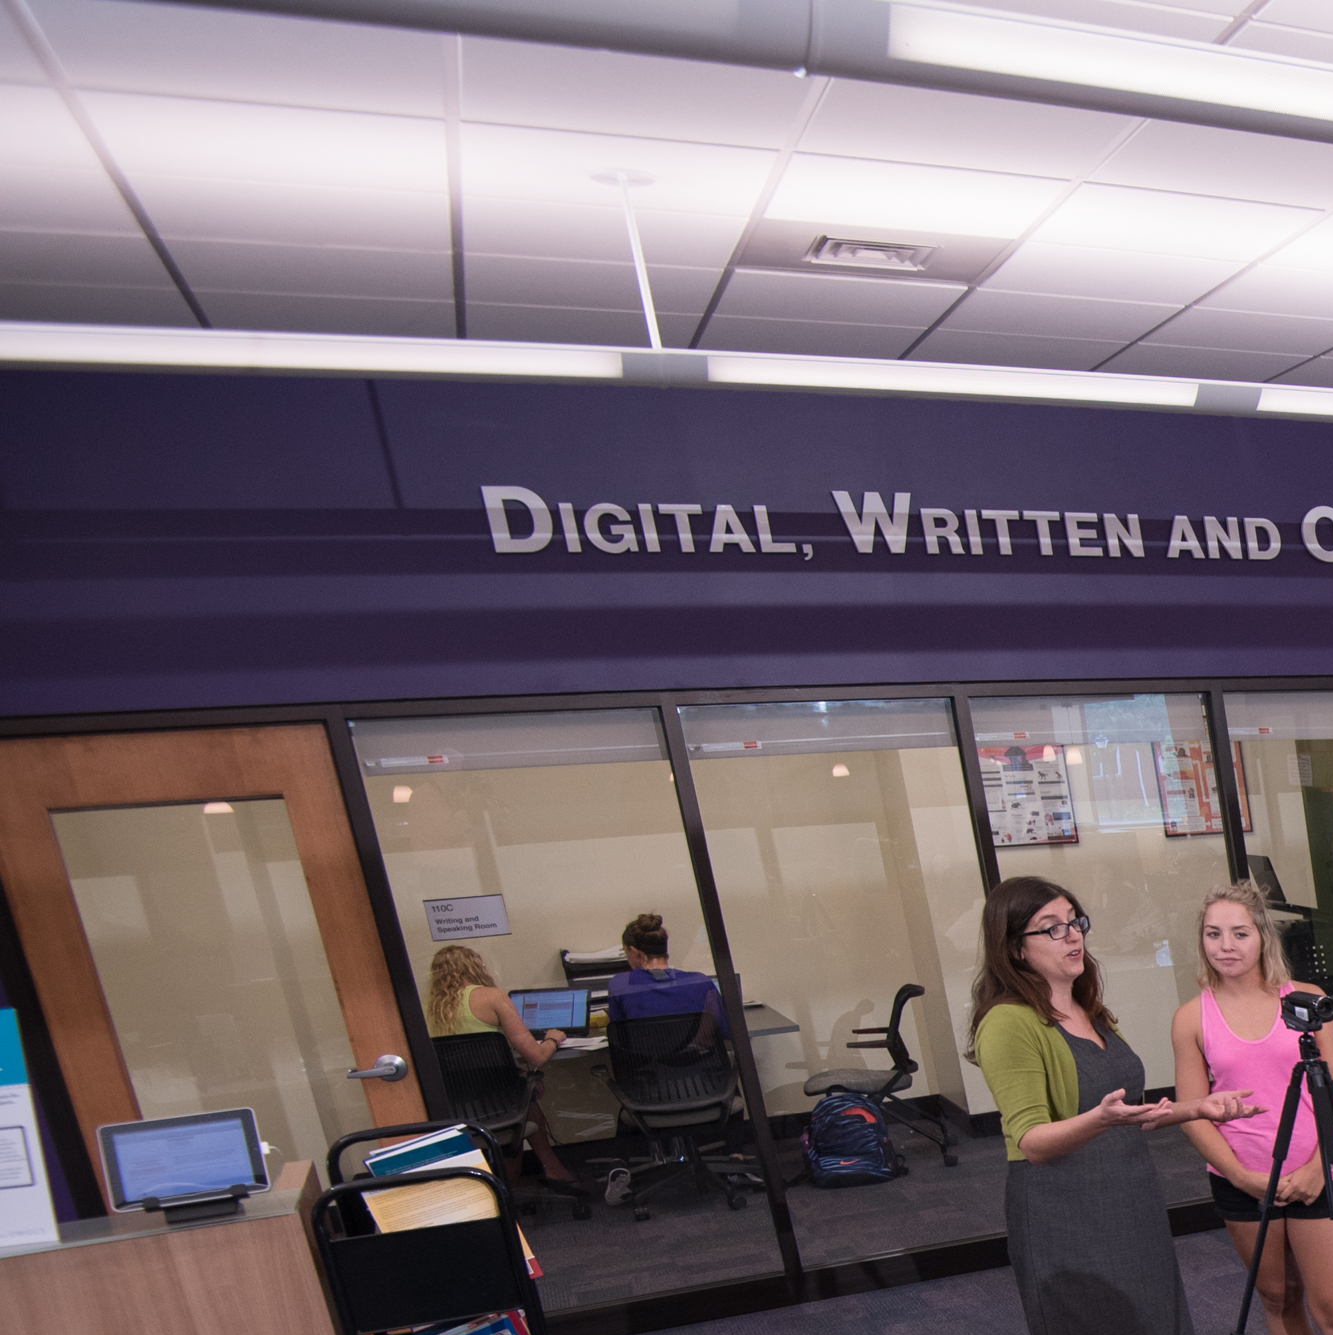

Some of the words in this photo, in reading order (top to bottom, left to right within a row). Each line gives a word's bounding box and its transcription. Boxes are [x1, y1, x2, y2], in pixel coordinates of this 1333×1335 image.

[830, 490, 1145, 558] WRITTEN
[1165, 514, 1282, 562] AND
[431, 904, 454, 913] 110C
[435, 917, 463, 926] Writing
[437, 924, 473, 934] Speaking
[475, 922, 497, 930] Room
